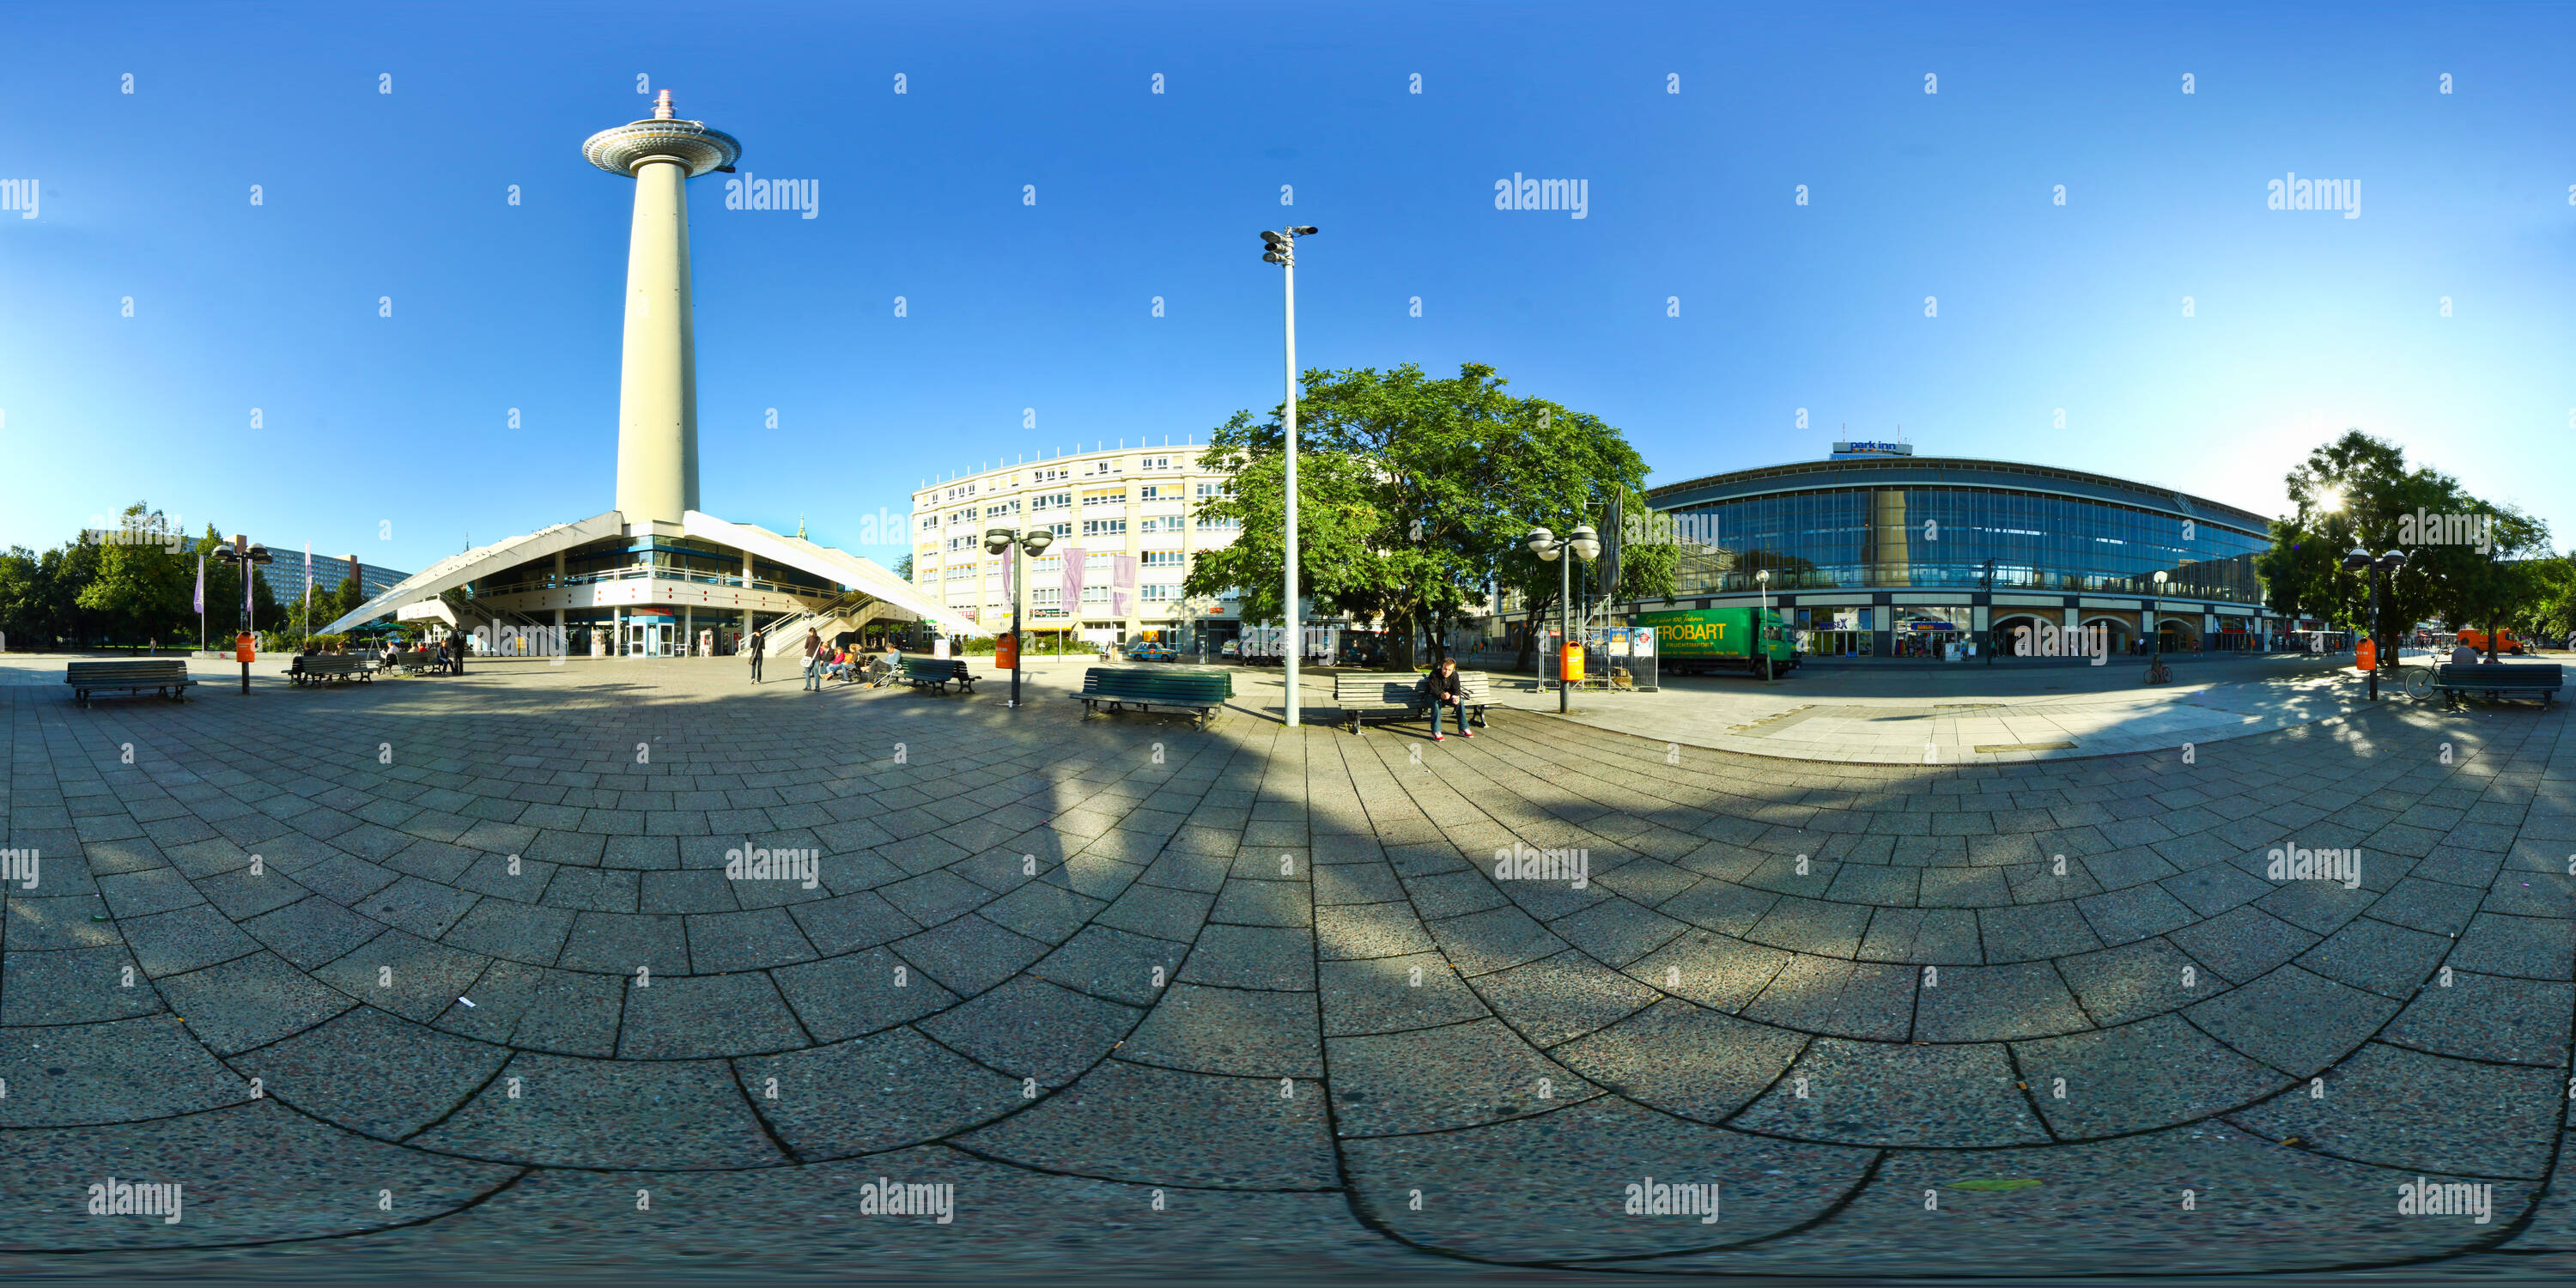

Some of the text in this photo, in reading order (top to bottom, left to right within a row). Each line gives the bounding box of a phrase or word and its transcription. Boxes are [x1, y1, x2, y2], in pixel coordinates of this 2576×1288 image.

[1850, 440, 1896, 453] park inn
[1655, 623, 1727, 640] FROBART
